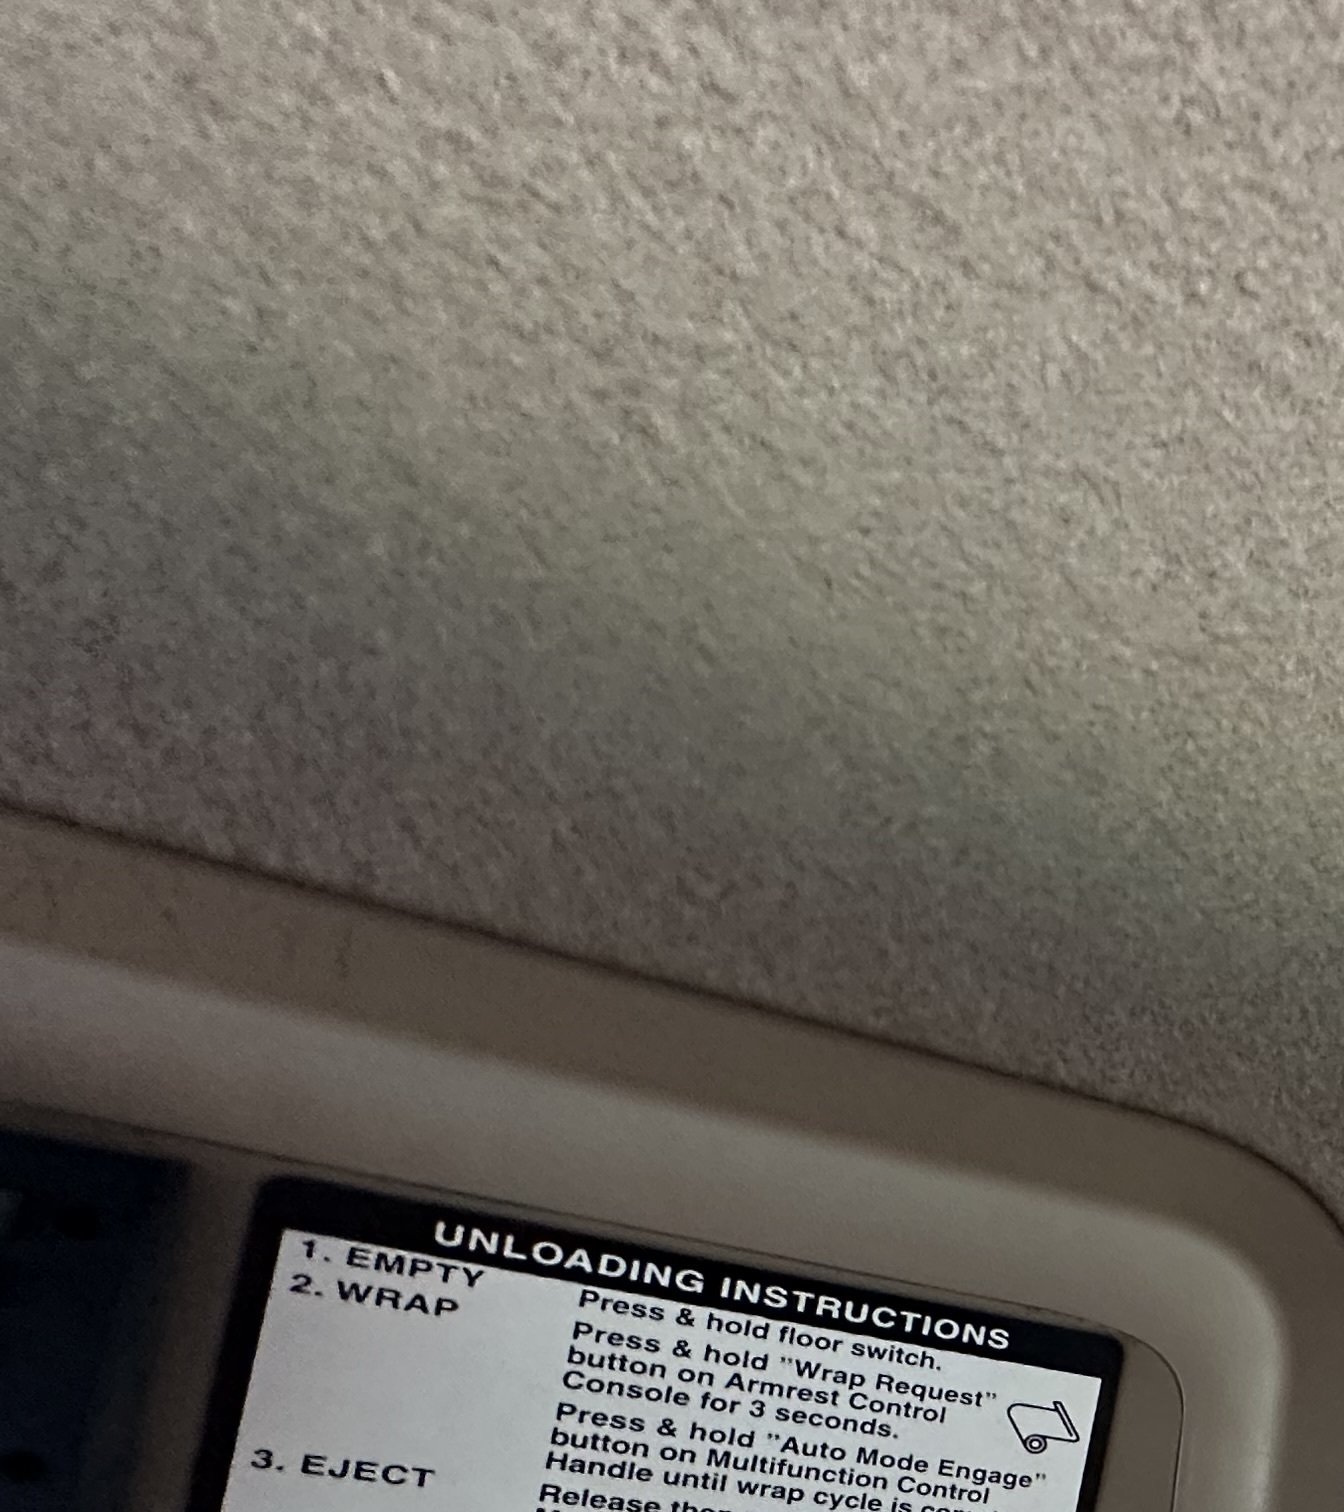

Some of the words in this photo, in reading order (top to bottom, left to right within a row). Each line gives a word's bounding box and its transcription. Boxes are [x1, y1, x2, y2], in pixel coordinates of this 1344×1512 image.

[289, 1273, 323, 1297] 2.
[337, 1280, 459, 1317] WRAP
[302, 1239, 330, 1263] 1.
[346, 1246, 484, 1288] EMPTY
[434, 1221, 704, 1294] UNLOADING
[720, 1277, 1010, 1350] INSTRUCTIONS
[572, 1320, 661, 1354] Press
[672, 1339, 692, 1359] &
[703, 1343, 769, 1371] hold
[578, 1288, 665, 1322] Press
[675, 1307, 695, 1327] &
[706, 1311, 770, 1340] hold
[778, 1325, 844, 1353] floor
[850, 1342, 941, 1371] switch.
[562, 1370, 690, 1406] Console
[700, 1391, 742, 1414] for
[749, 1399, 766, 1418] 3
[775, 1407, 898, 1439] seconds.
[567, 1344, 667, 1379] button
[677, 1368, 715, 1387] on
[724, 1372, 840, 1407] Armrest
[848, 1392, 947, 1424] Control
[250, 1448, 284, 1472] 3.
[300, 1454, 436, 1488] EJECT
[550, 1426, 650, 1458] button
[659, 1446, 697, 1464] on
[706, 1448, 888, 1490] Multifunction
[897, 1475, 990, 1504] Control
[556, 1401, 645, 1433] Press
[656, 1417, 677, 1438] &
[689, 1421, 755, 1449] hold
[856, 1446, 929, 1473] Mode
[545, 1450, 654, 1482] Handle
[663, 1470, 728, 1492] until
[737, 1480, 805, 1505] wrap
[813, 1491, 883, 1512] cycle
